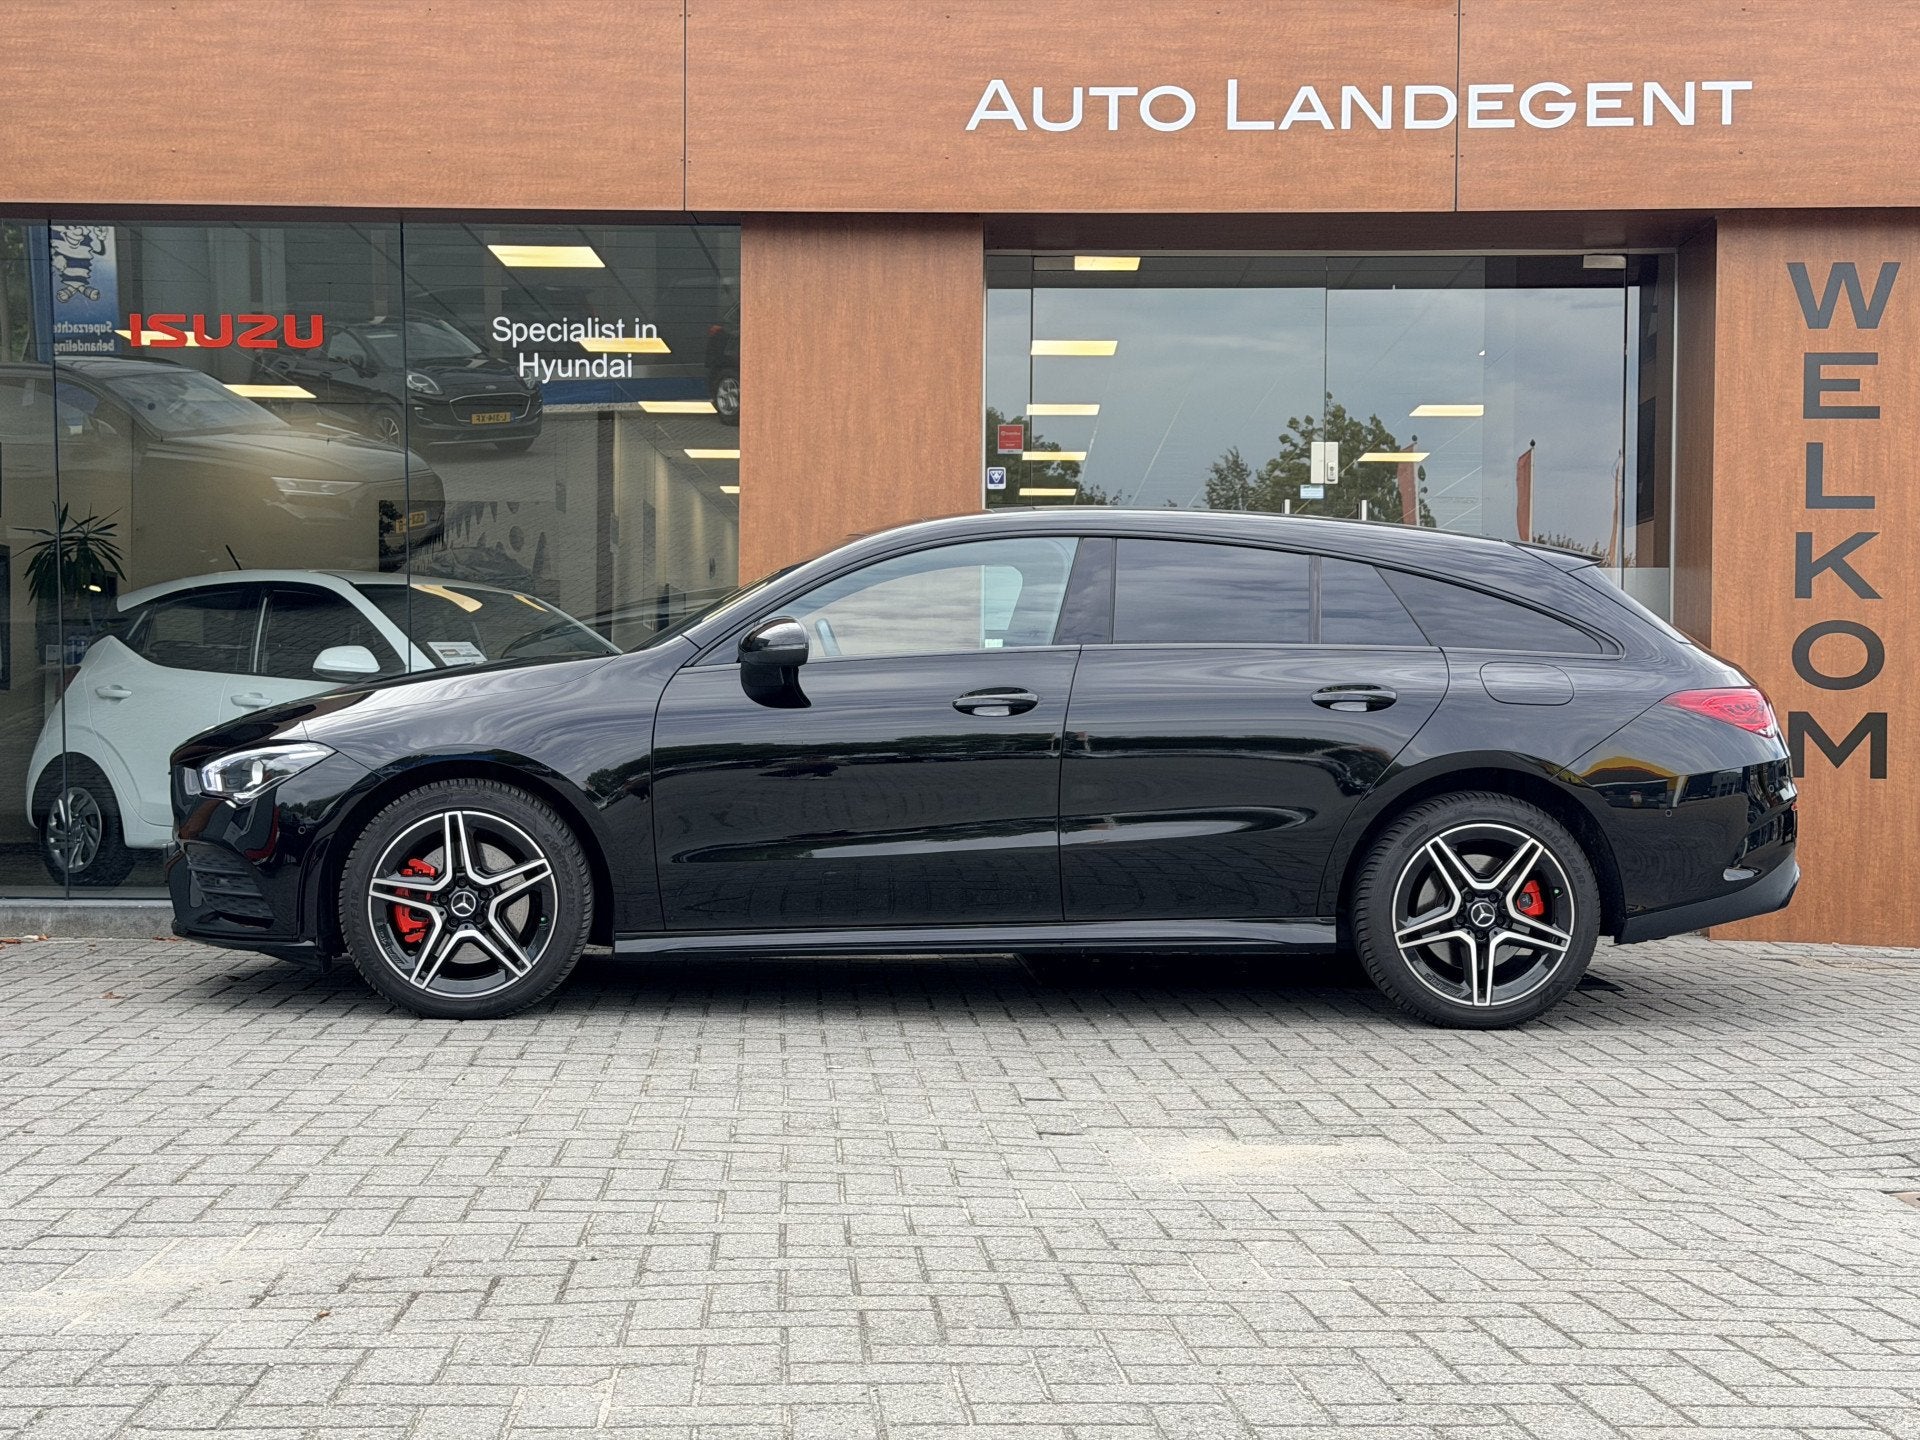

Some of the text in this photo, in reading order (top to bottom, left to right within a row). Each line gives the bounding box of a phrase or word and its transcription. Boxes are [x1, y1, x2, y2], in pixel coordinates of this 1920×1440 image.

[965, 79, 1753, 132] AUTO LANDEGENT
[129, 313, 324, 349] ISUZU
[492, 316, 657, 348] Specialist in
[519, 352, 633, 384] Hyundai
[1787, 261, 1901, 780] WELKOM
